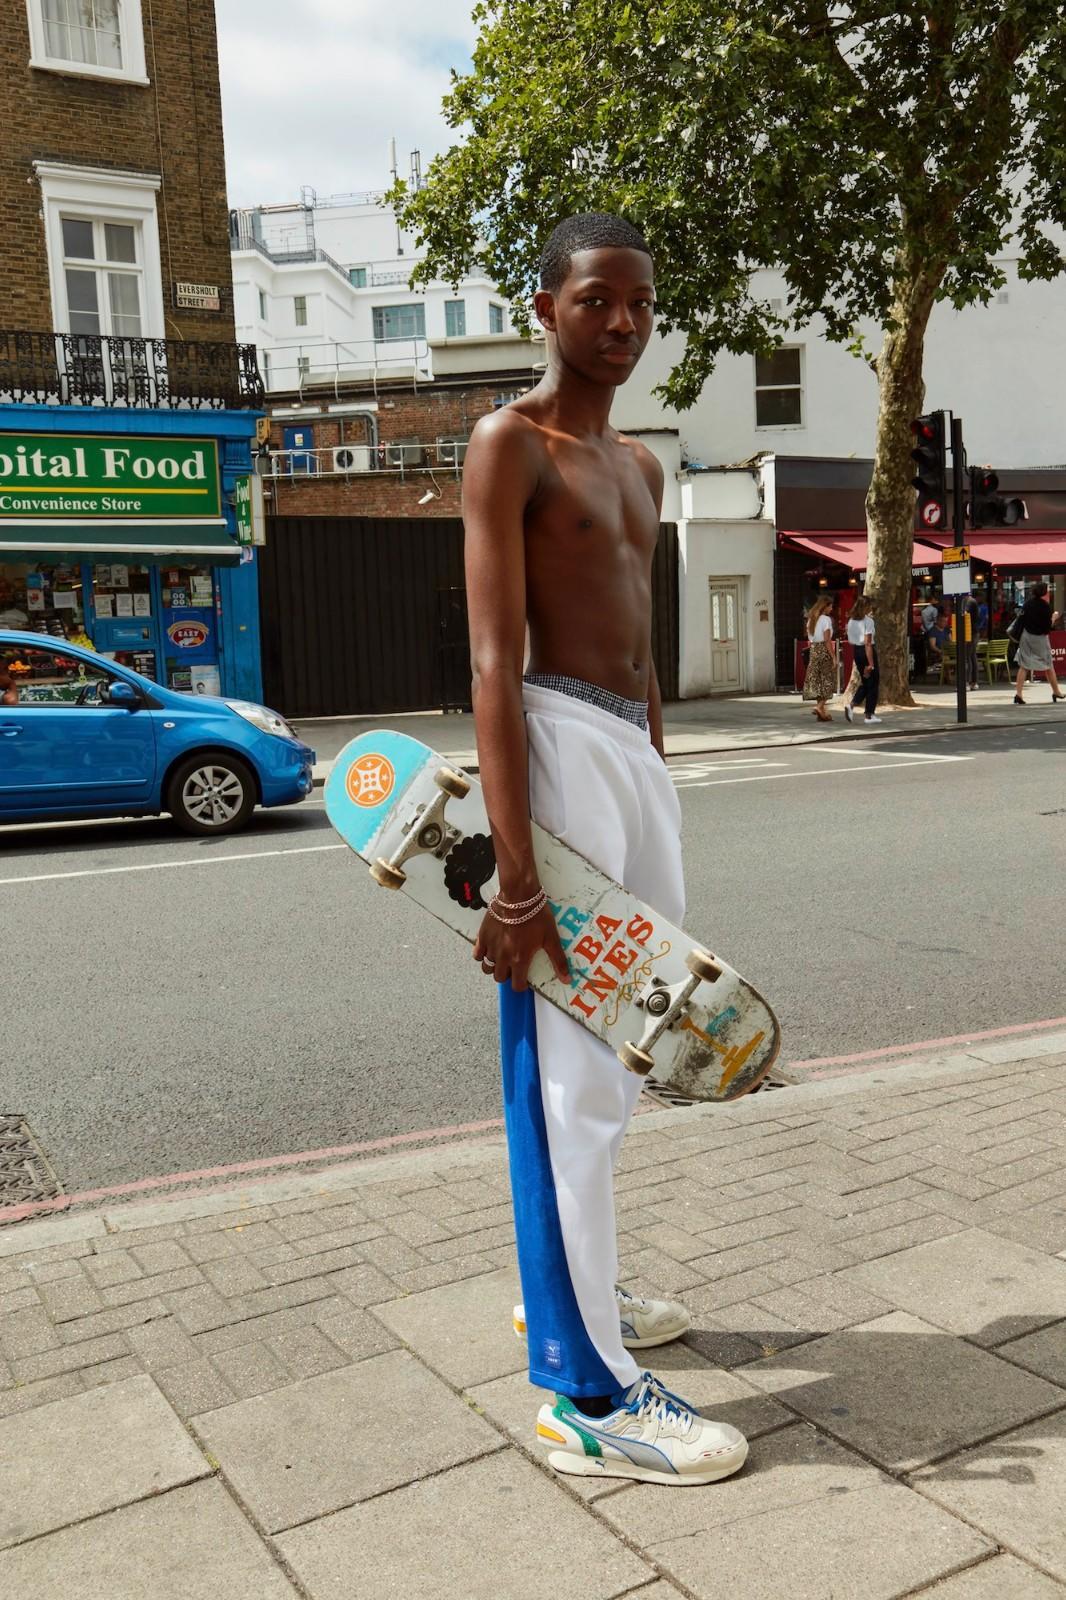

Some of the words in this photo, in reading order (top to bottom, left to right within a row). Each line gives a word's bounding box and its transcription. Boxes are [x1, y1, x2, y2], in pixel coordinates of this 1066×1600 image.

[179, 284, 216, 296] EVERSHOLT
[178, 297, 205, 307] STREET
[101, 448, 207, 480] Food
[0, 495, 98, 510] Convenience
[101, 497, 141, 510] Store
